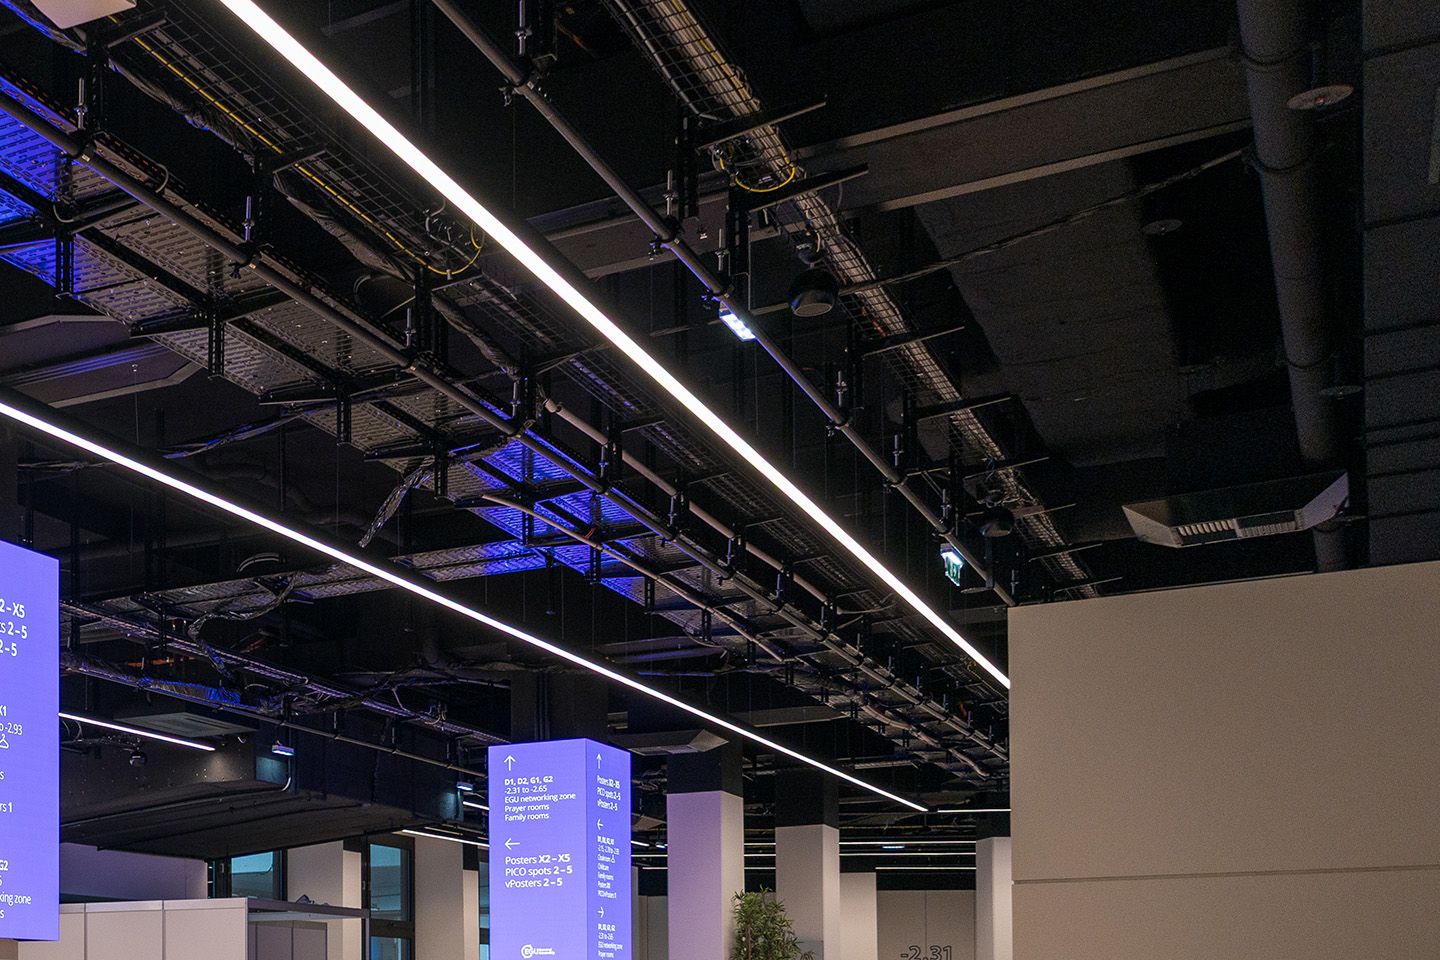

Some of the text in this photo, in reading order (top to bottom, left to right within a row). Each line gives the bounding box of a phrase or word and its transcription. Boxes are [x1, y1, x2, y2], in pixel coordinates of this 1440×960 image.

[5, 722, 23, 735] -2.93
[522, 786, 530, 794] to
[504, 796, 519, 804] EGU
[520, 793, 558, 802] networking
[8, 802, 13, 813] 1
[504, 803, 550, 814] Prayer rooms
[504, 812, 550, 822] Family rooms
[505, 856, 537, 865] Posters
[505, 867, 527, 877] PICO
[528, 867, 552, 878] spots
[504, 879, 542, 888] vPosters
[14, 894, 32, 905] zone
